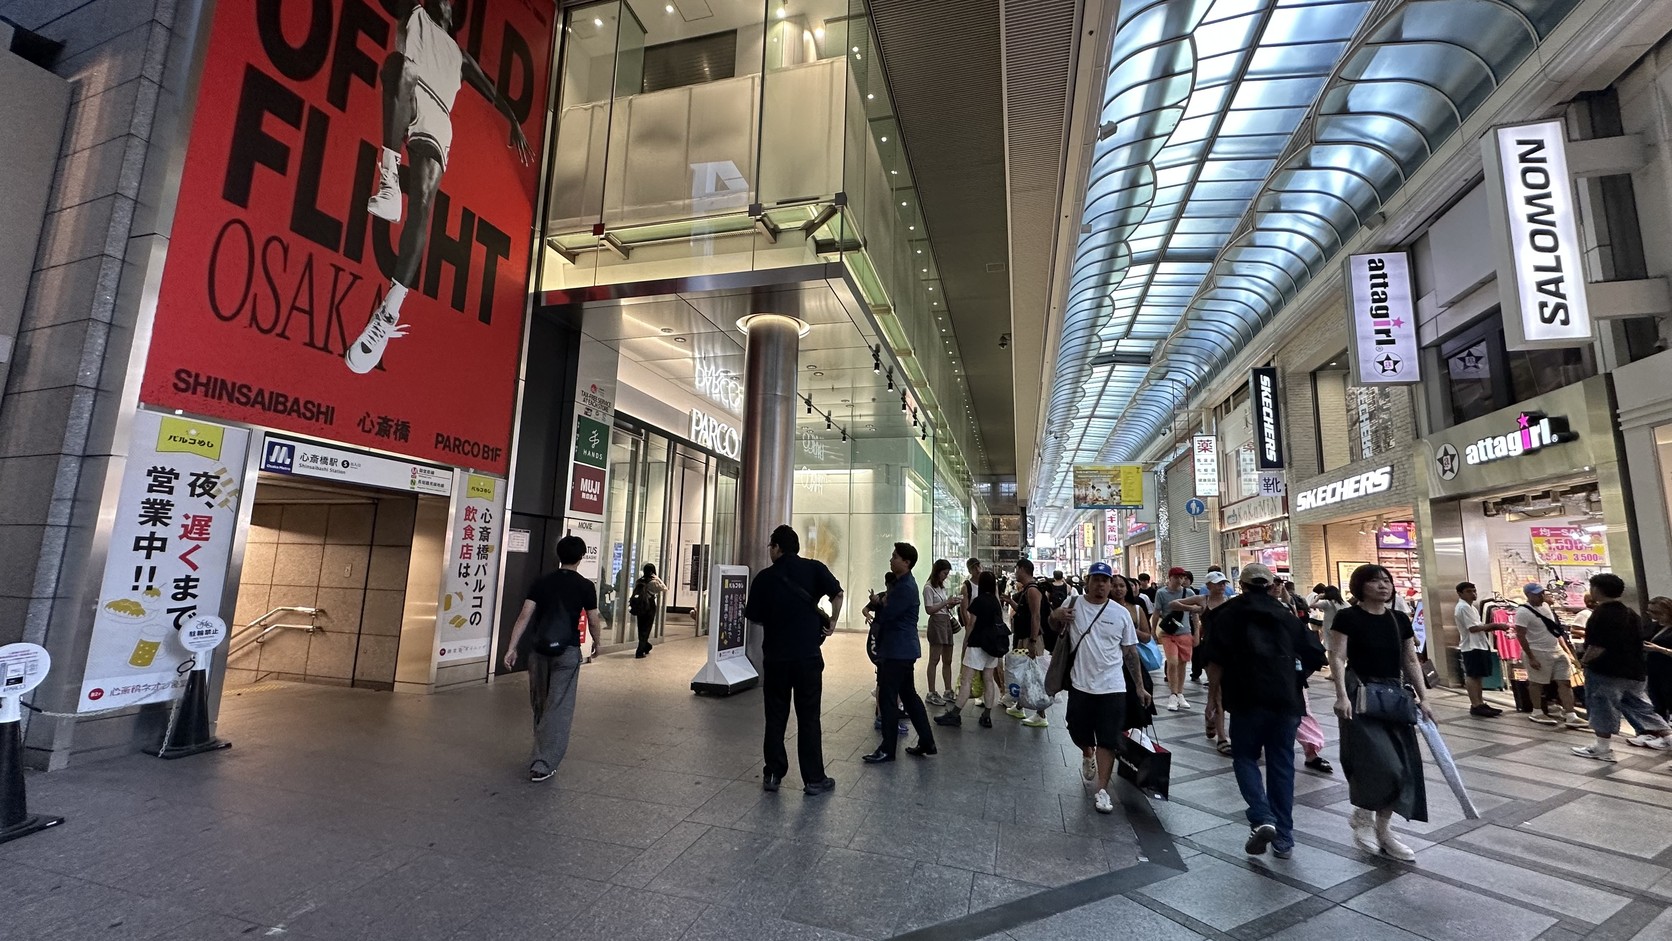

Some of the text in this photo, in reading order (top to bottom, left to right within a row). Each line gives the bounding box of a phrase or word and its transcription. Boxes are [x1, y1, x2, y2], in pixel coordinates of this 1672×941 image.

[1516, 139, 1570, 326] SALOMON
[172, 367, 335, 427] SHINSAIBASHI
[356, 411, 412, 443] 心斎橋
[691, 408, 739, 459] PARCO
[1260, 375, 1277, 462] SKECHERS
[300, 452, 339, 467] 心斎橋駅
[435, 432, 502, 463] PARCO B1F
[583, 449, 603, 460] HANDS
[1197, 439, 1213, 453] 薬
[299, 463, 328, 472] Shinsaibashi
[580, 478, 601, 494] MUJI
[1263, 477, 1282, 494] 靴
[1297, 466, 1391, 512] SKECHERS
[578, 522, 593, 530] MOVIE
[166, 471, 221, 631] 夜、遅くまで
[458, 505, 478, 587] 飲食店は、
[469, 508, 493, 627] 心斎橋パルコの
